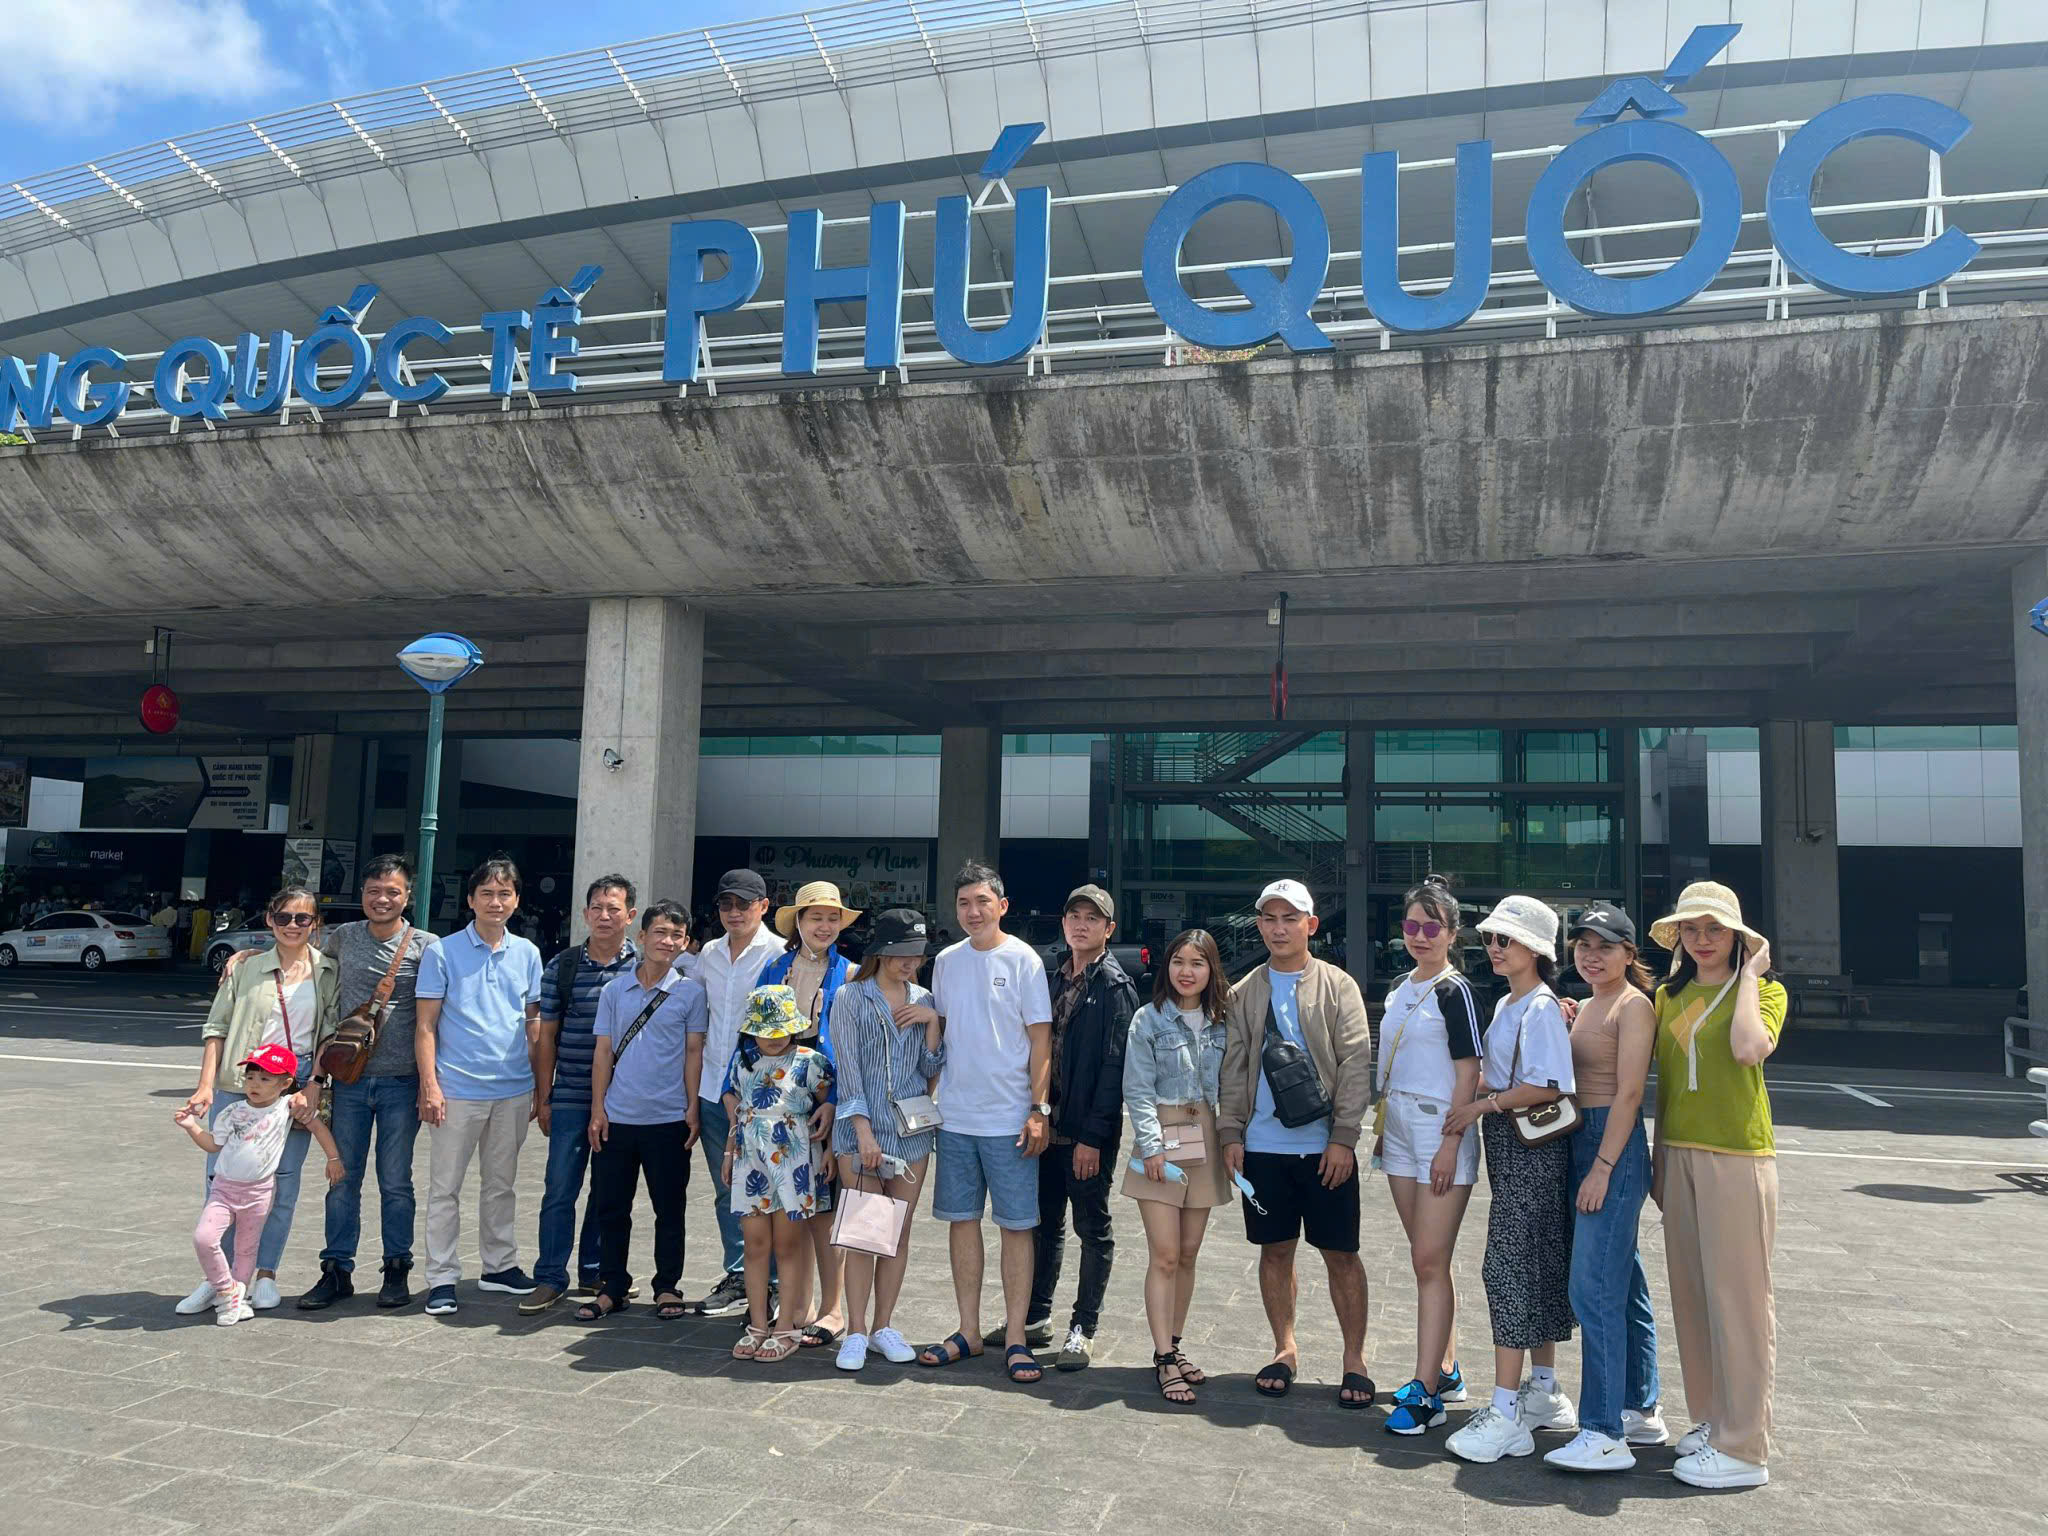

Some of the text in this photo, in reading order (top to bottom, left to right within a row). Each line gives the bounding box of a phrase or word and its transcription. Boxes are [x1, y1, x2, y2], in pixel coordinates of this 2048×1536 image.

[152, 284, 455, 422] QUỐC
[480, 264, 604, 397] TẾ
[661, 123, 1049, 385] PHÚ
[1141, 24, 1980, 353] QUỐC
[90, 849, 123, 861] market
[866, 846, 921, 872] Nam
